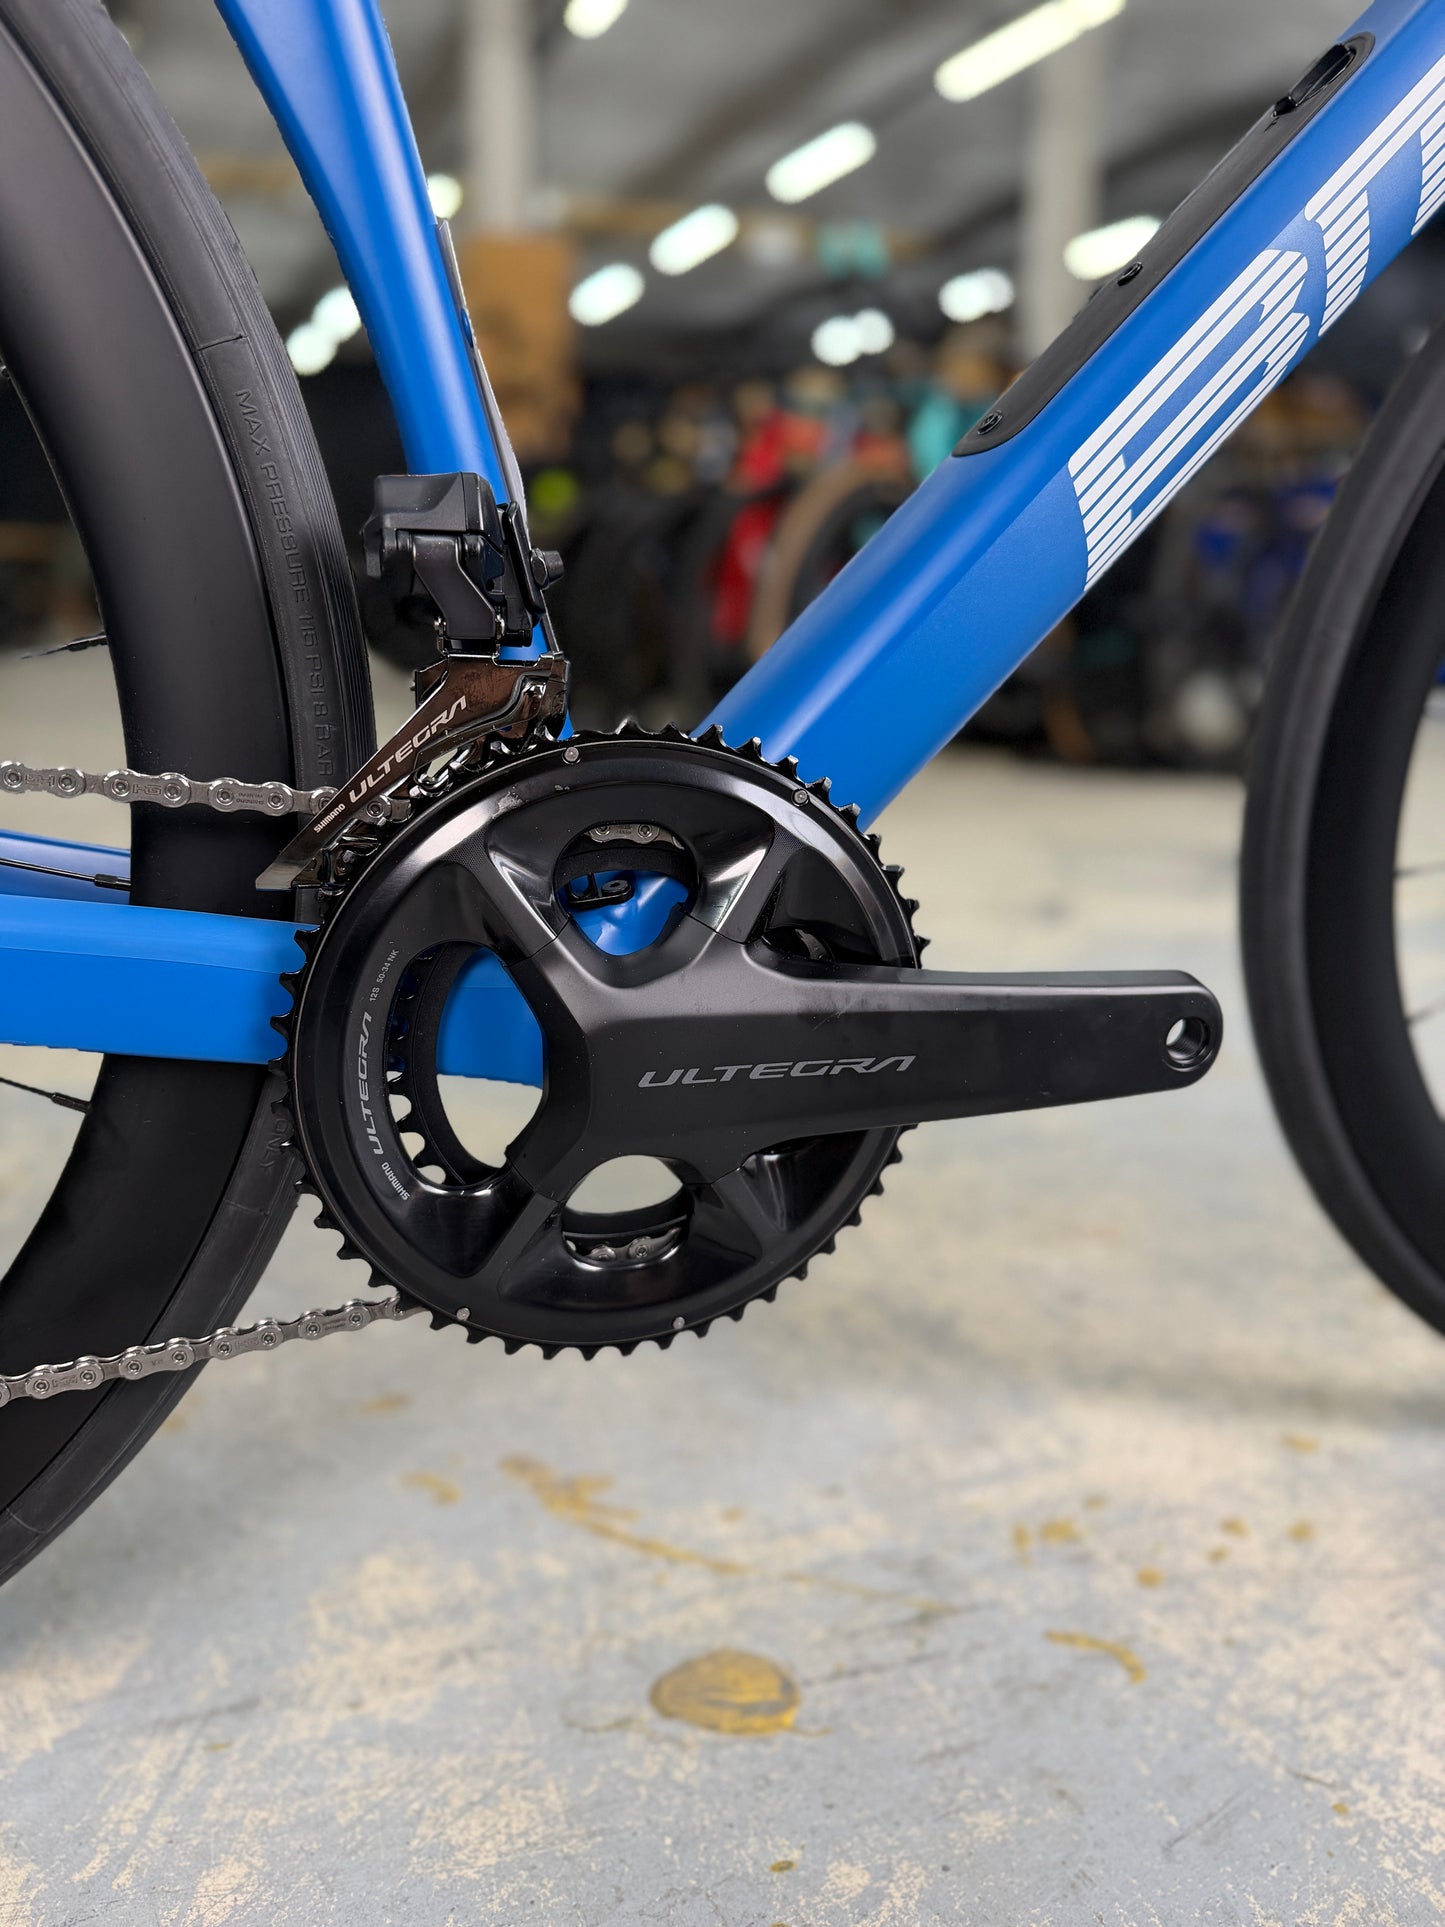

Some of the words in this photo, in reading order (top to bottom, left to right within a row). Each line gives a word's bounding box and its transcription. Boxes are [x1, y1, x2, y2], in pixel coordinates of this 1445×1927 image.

[234, 388, 271, 455] MAX
[260, 461, 311, 603] PRESSURE
[299, 613, 318, 647] 115
[305, 653, 325, 694] PSI
[313, 701, 328, 717] 8
[313, 803, 346, 833] SHIMANO
[349, 695, 467, 803] ULTEGRA
[314, 722, 335, 777] BAR
[369, 986, 380, 1002] 12S
[376, 962, 391, 984] 50-34
[358, 1011, 384, 1156] ULTEGRA
[638, 1055, 917, 1088] ULTEGRA
[381, 1161, 411, 1201] SHIMANO
